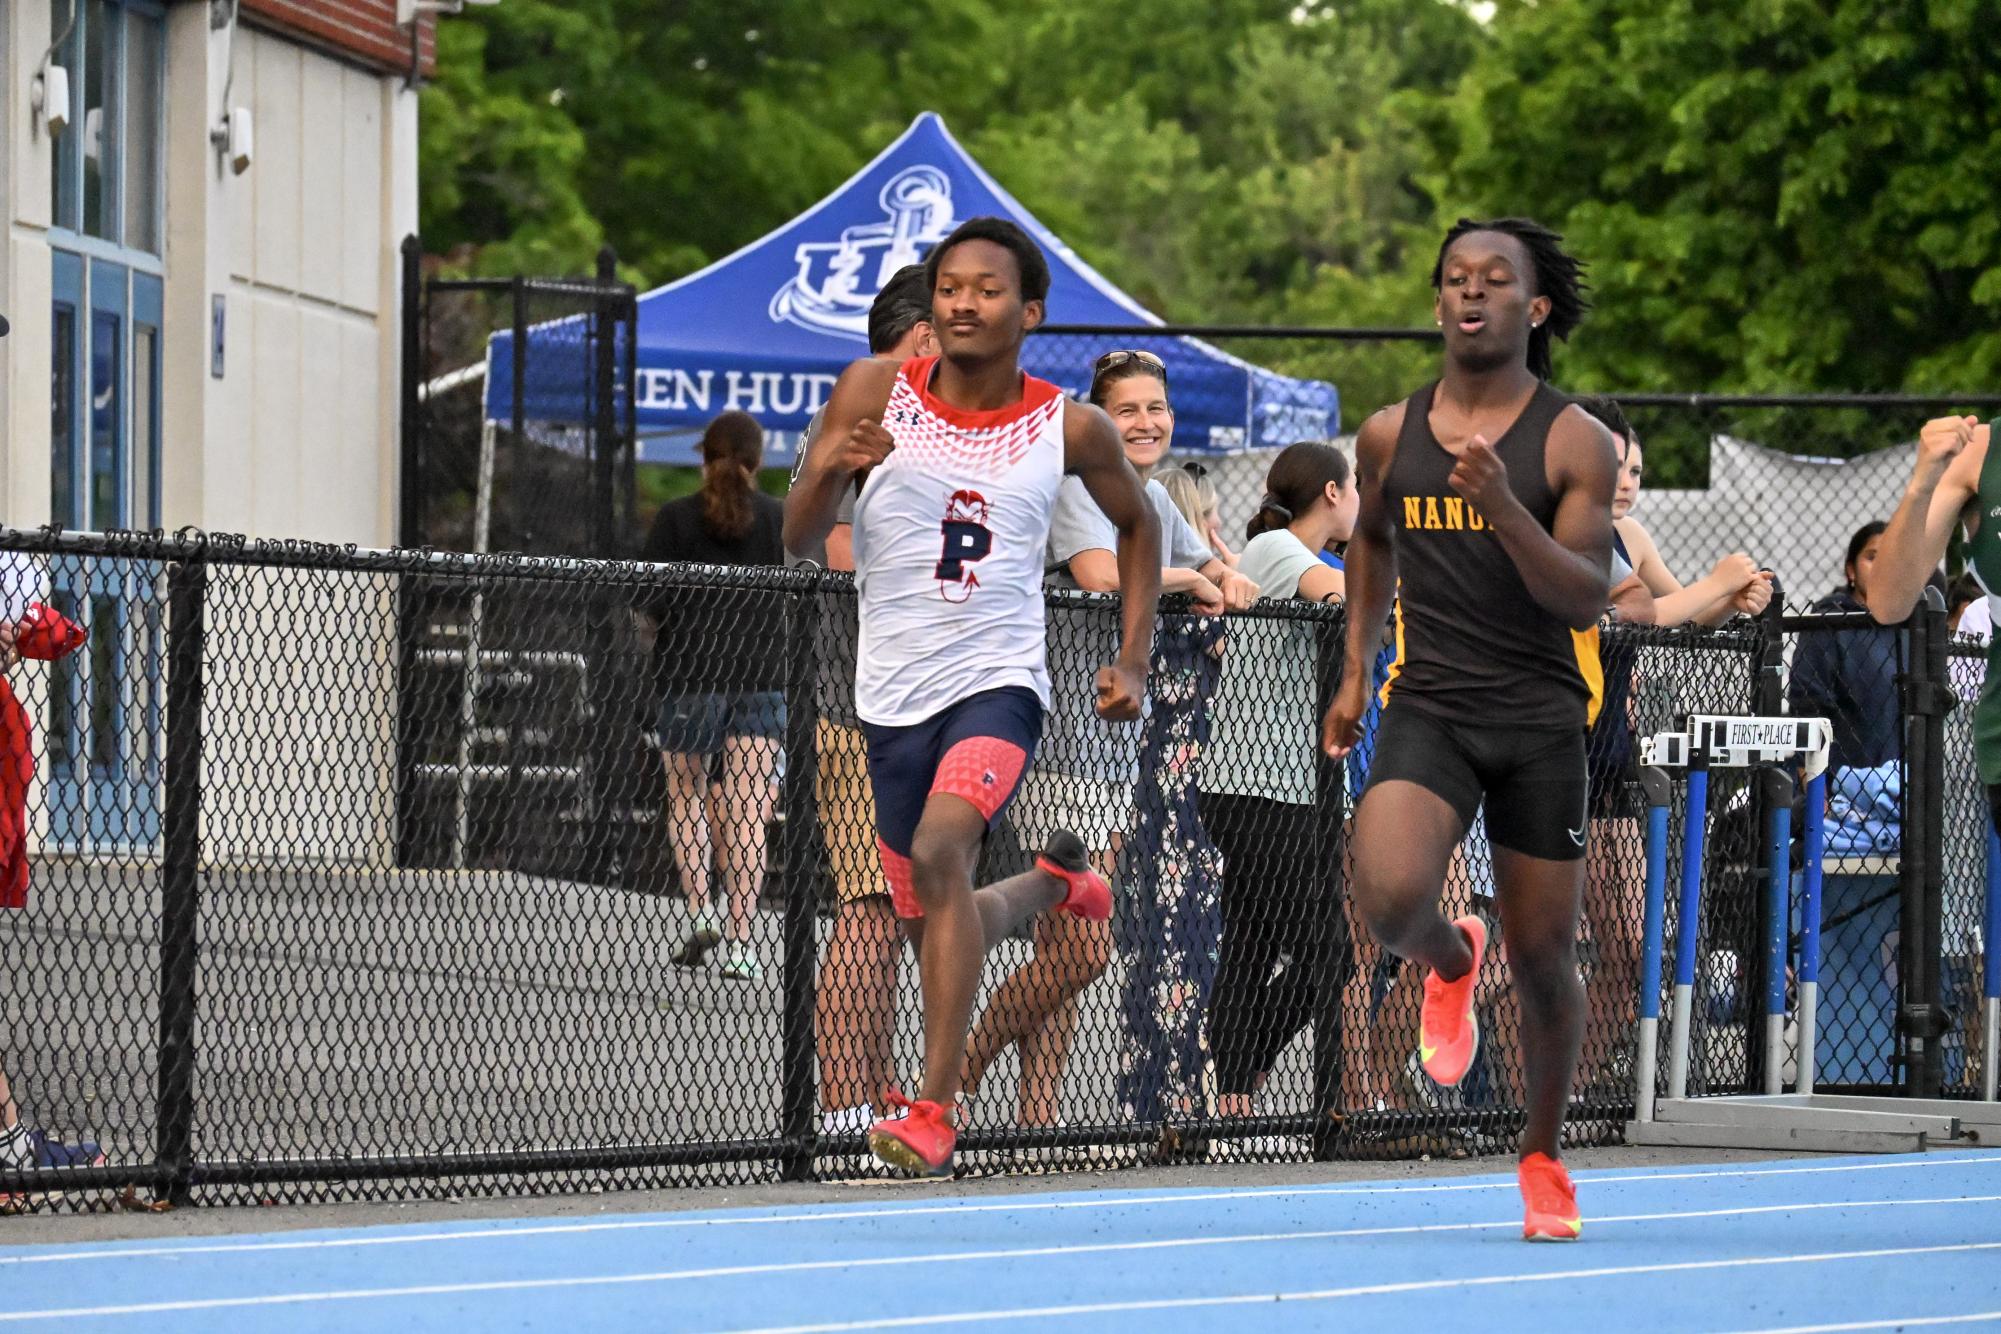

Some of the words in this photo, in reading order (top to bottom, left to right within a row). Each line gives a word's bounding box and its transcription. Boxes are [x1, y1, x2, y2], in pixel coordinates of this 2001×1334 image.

[1403, 496, 1495, 531] NANU
[934, 518, 993, 583] P
[1731, 723, 1759, 745] FIRST
[1763, 724, 1793, 746] PLACE
